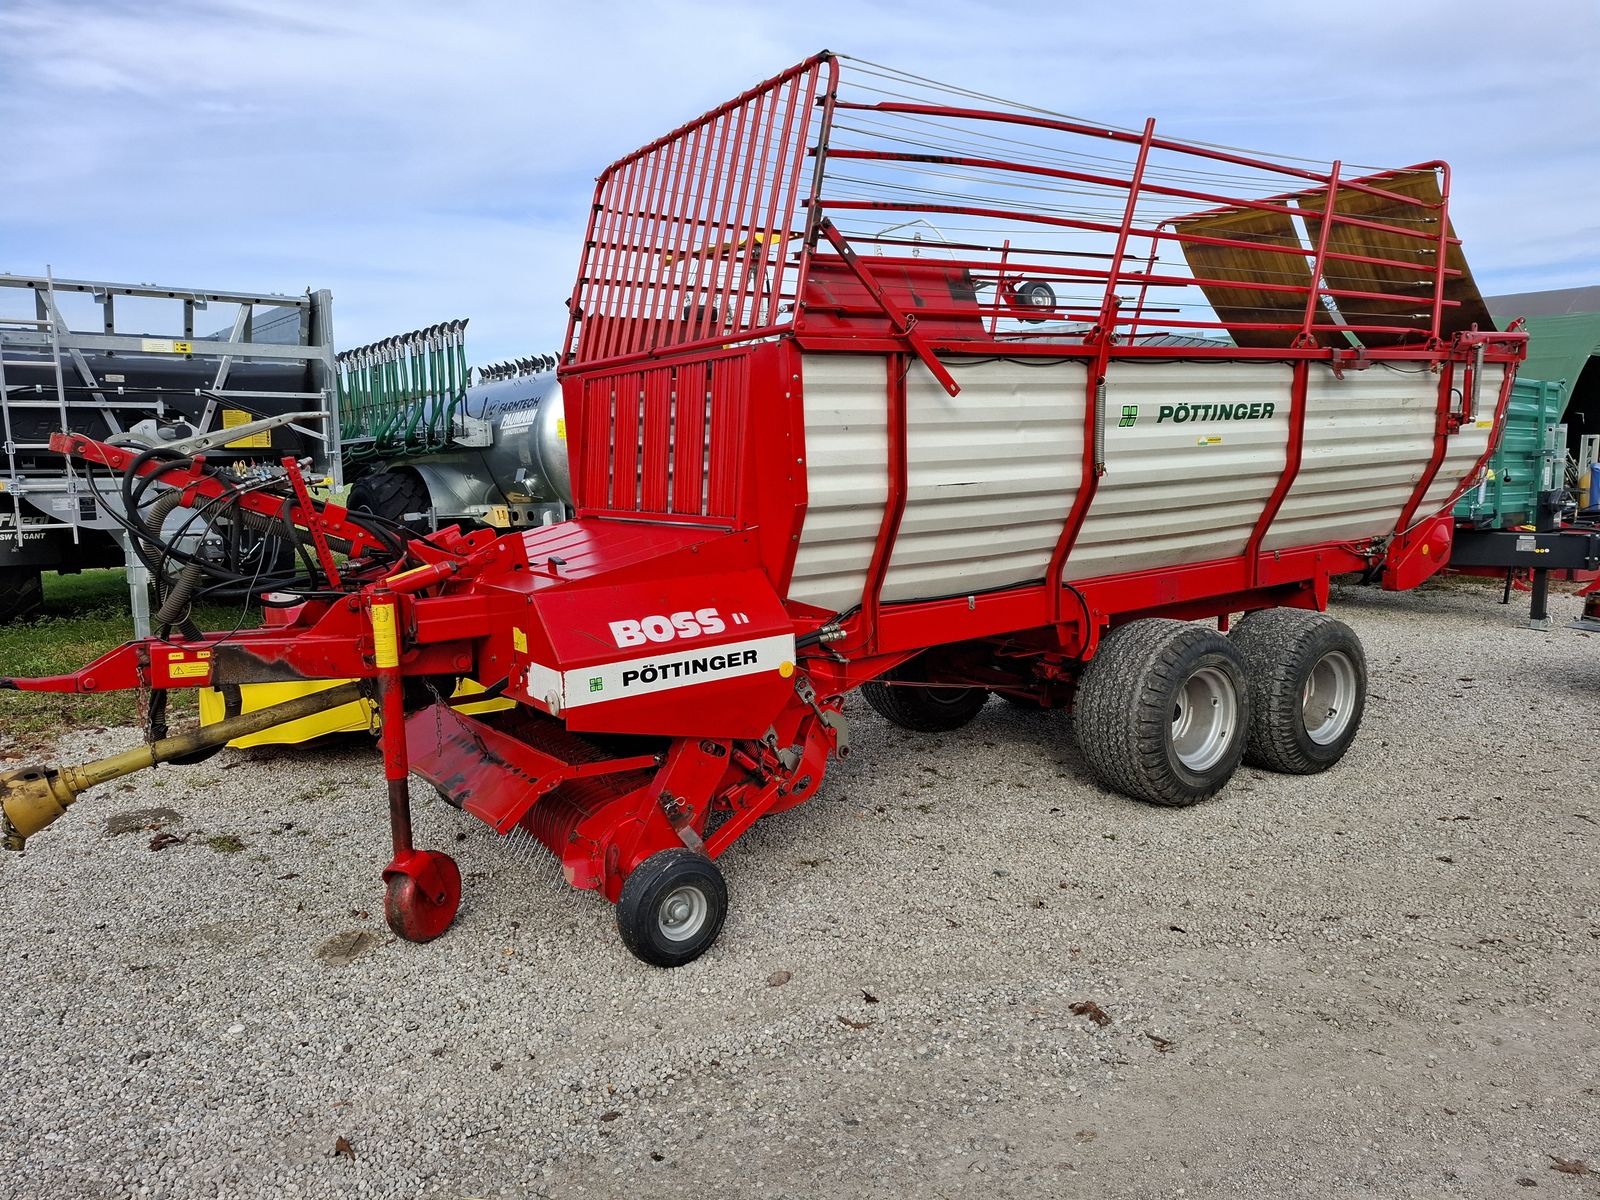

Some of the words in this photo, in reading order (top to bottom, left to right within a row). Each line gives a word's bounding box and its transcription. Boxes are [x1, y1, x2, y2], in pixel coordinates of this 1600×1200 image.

[498, 397, 541, 414] FARMTECH
[1156, 402, 1275, 424] PÖTTINGER
[500, 409, 538, 429] PAUMANN
[14, 532, 46, 541] GGANT
[608, 608, 726, 649] BOSS
[622, 649, 758, 687] PÖTTINGER
